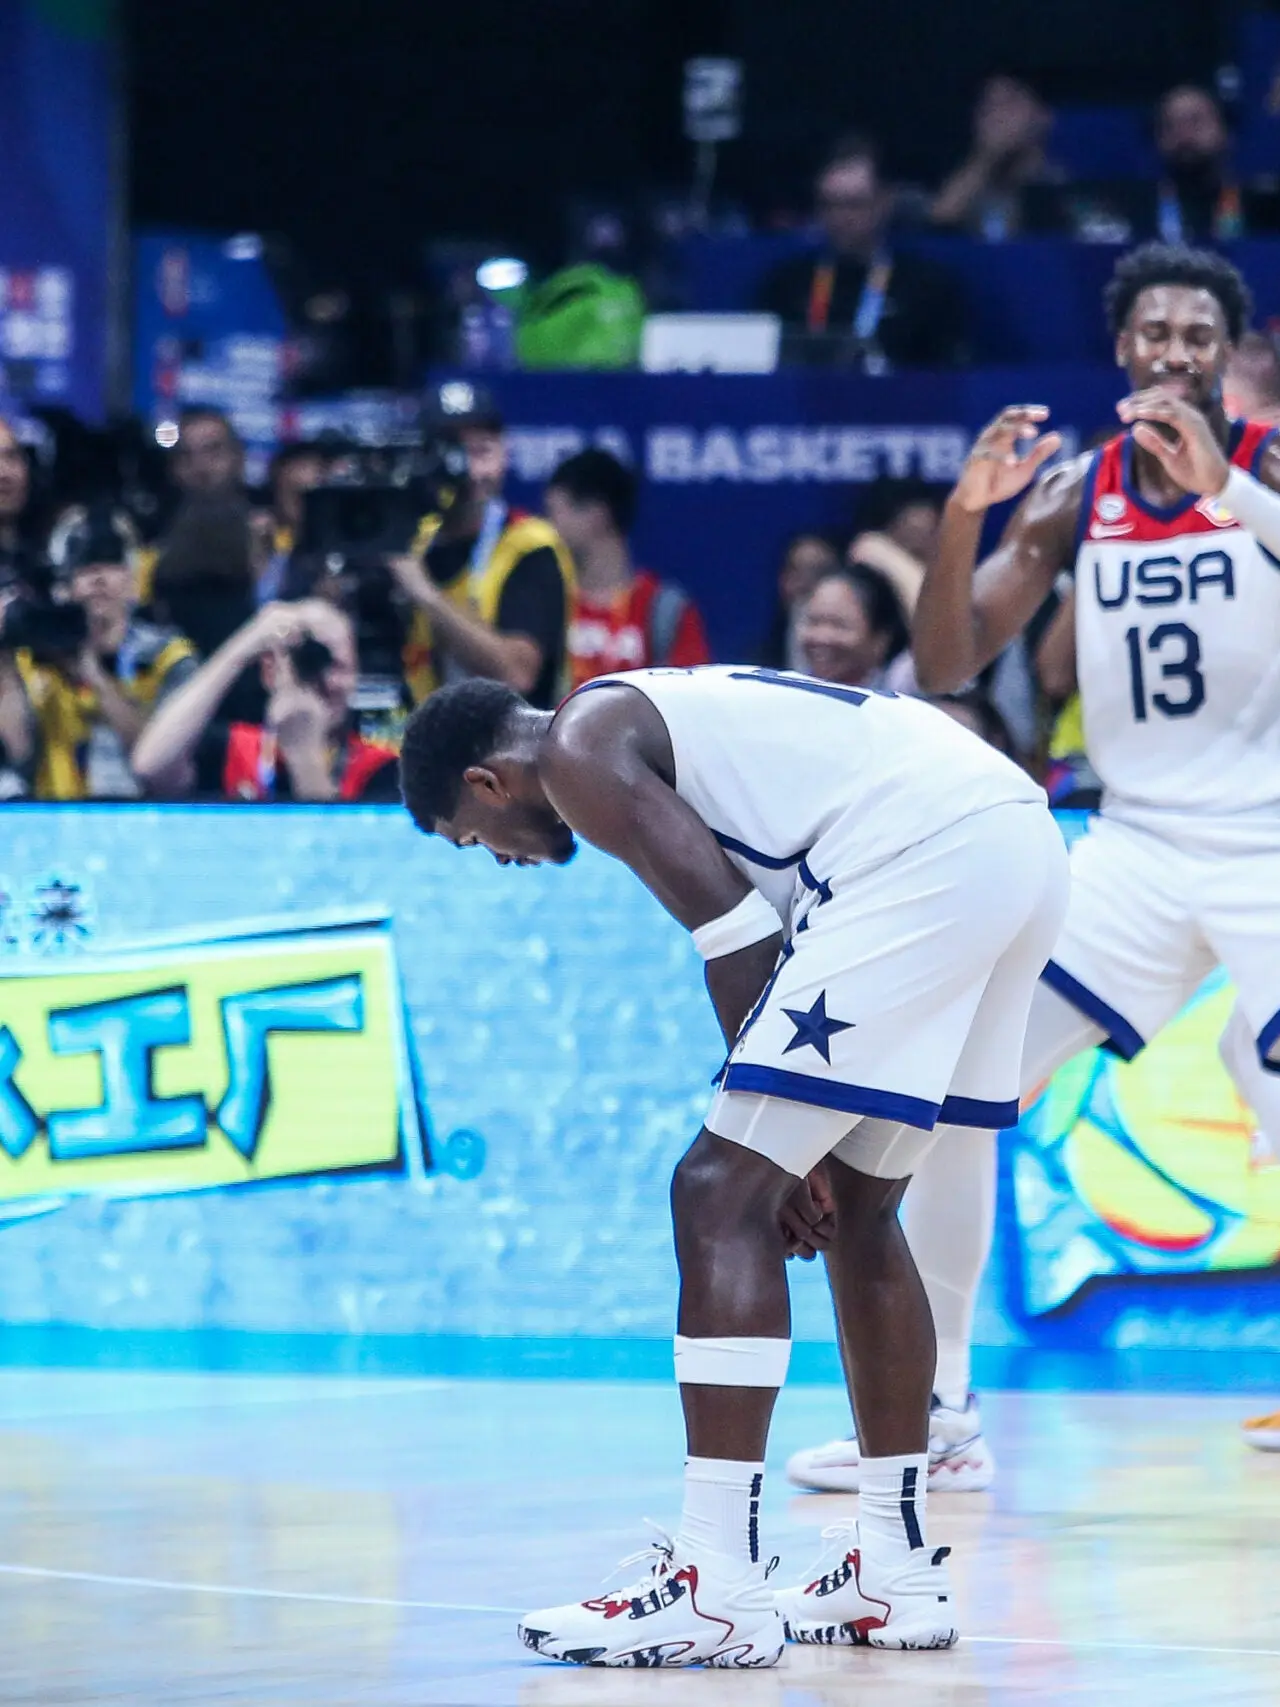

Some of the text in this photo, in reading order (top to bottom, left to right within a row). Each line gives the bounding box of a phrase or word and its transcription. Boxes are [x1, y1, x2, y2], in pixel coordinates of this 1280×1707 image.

[644, 424, 1074, 483] BASKETB
[1094, 550, 1236, 609] USA
[1126, 622, 1206, 723] 13
[0, 972, 364, 1163] 工厂
